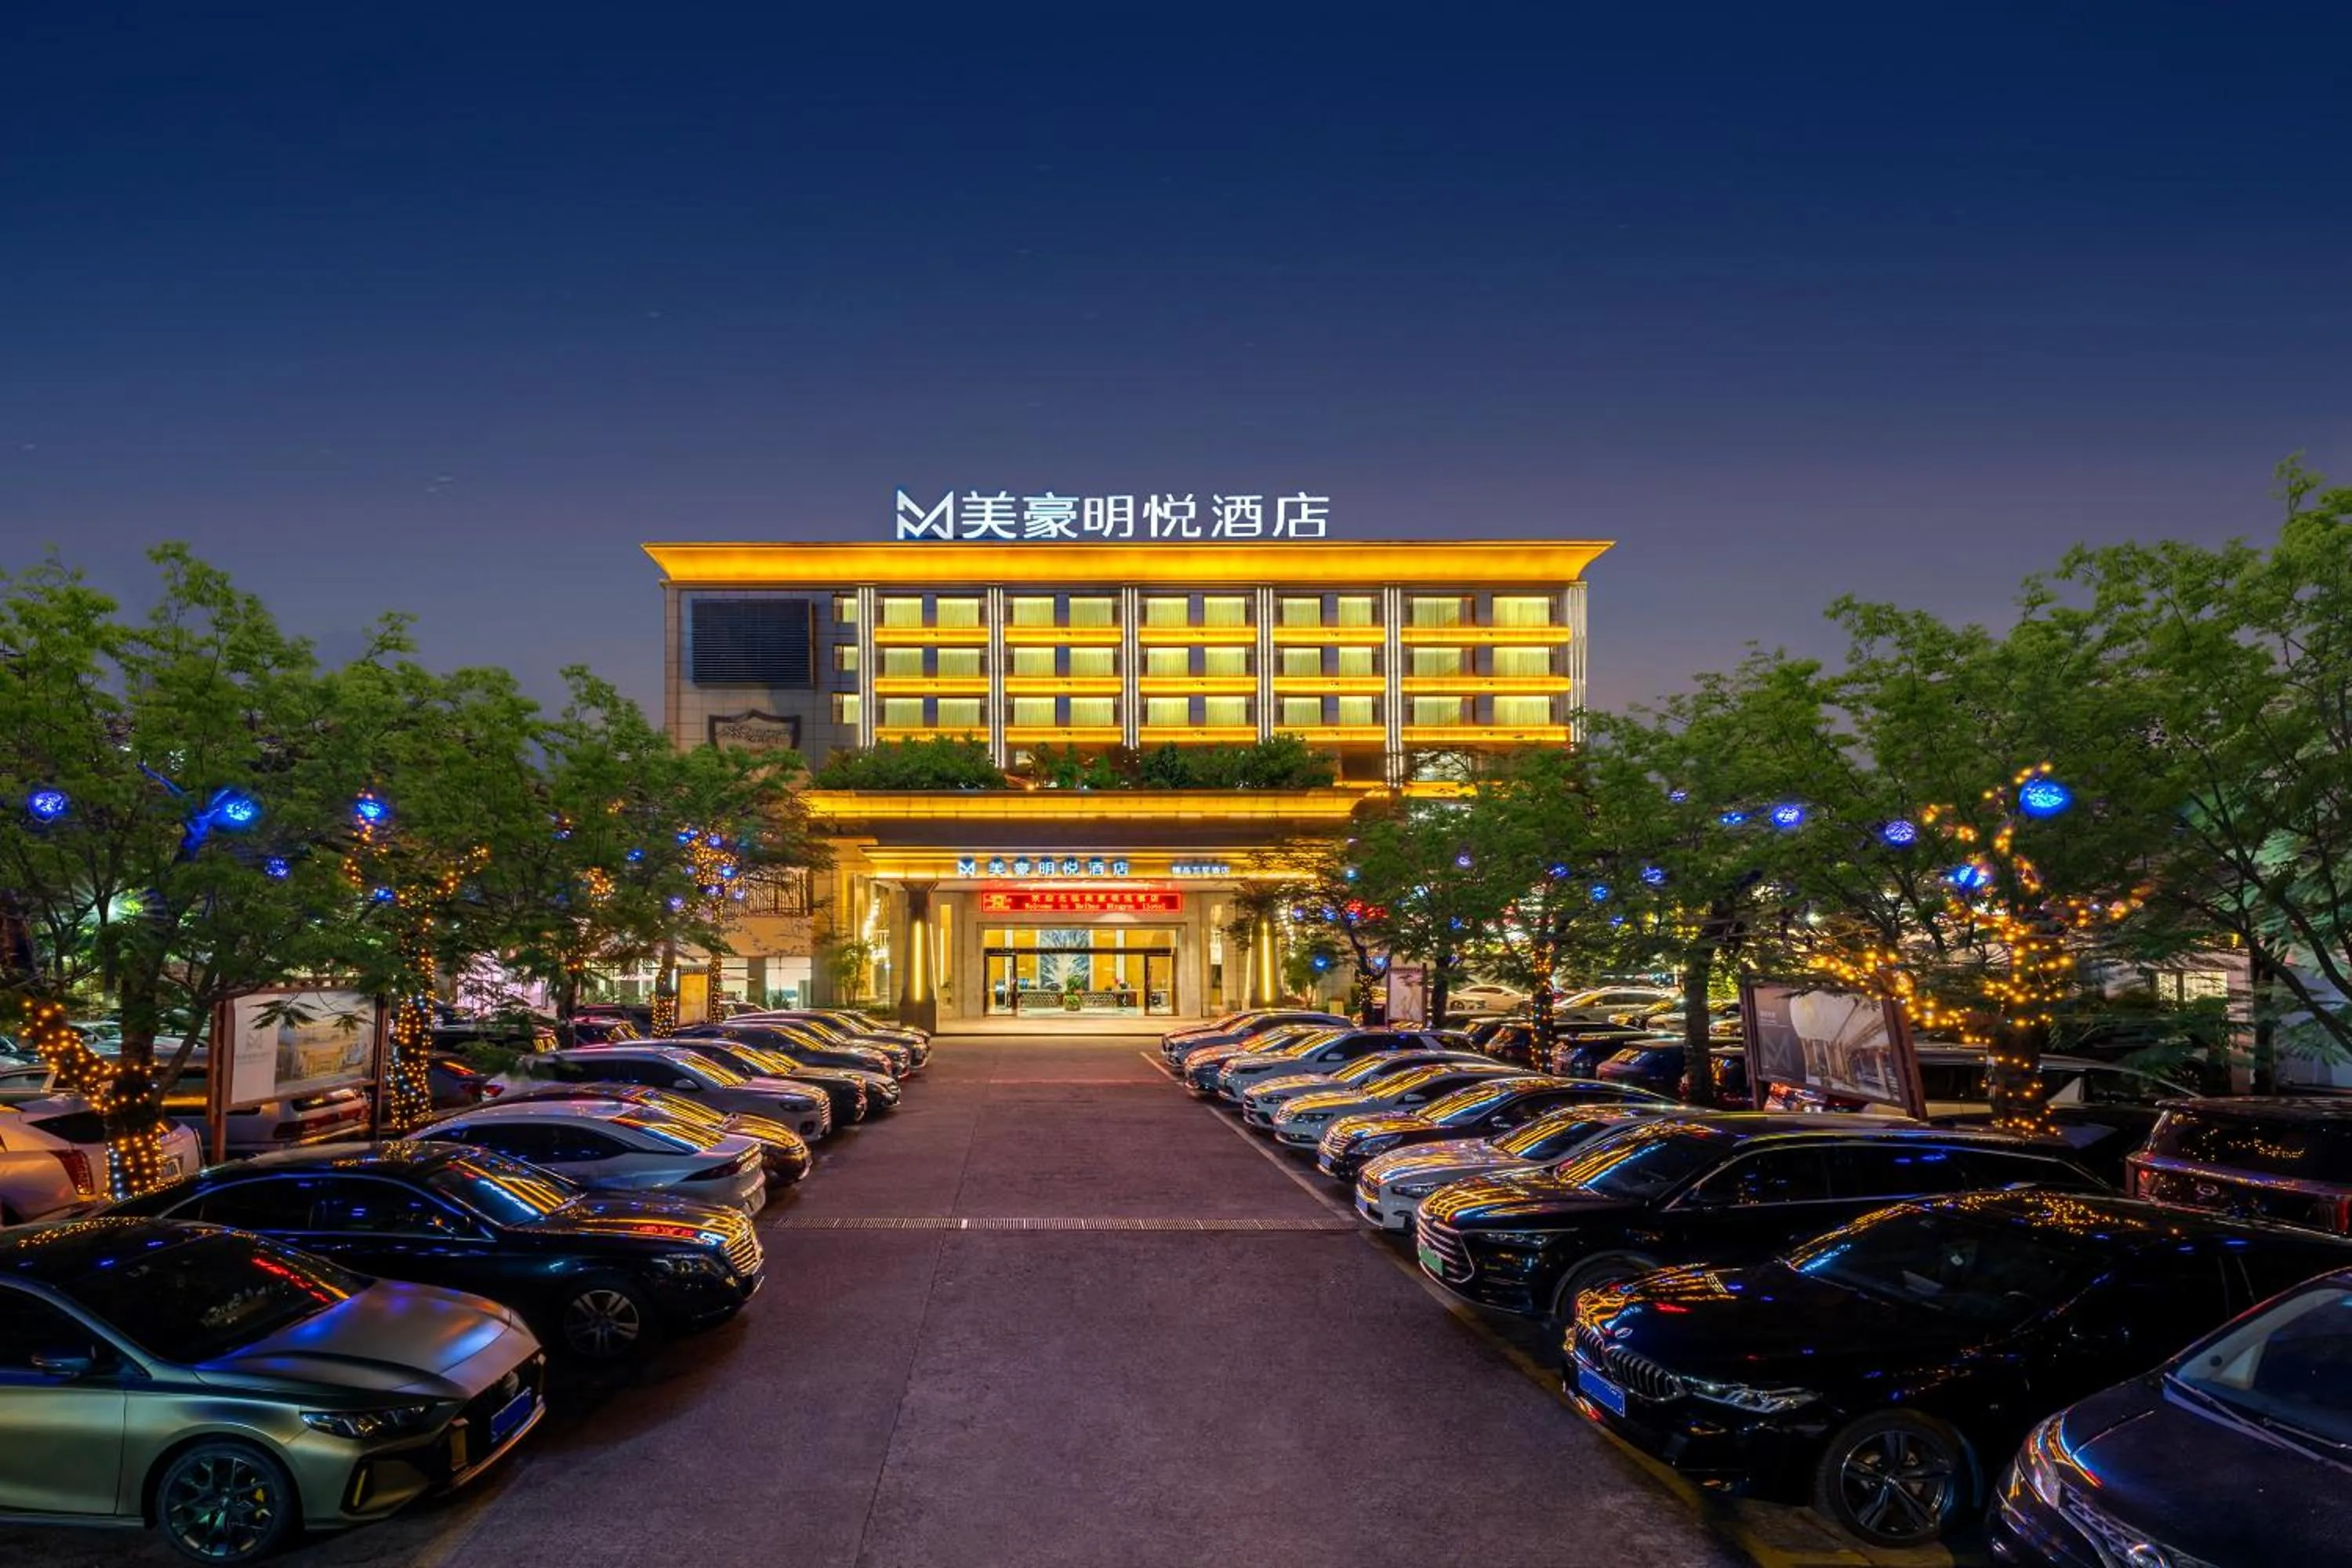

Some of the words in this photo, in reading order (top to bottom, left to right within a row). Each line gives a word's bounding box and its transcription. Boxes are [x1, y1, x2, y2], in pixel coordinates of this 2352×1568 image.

[960, 489, 1330, 539] 美豪明悦酒店
[988, 858, 1130, 877] 美豪明悦酒店
